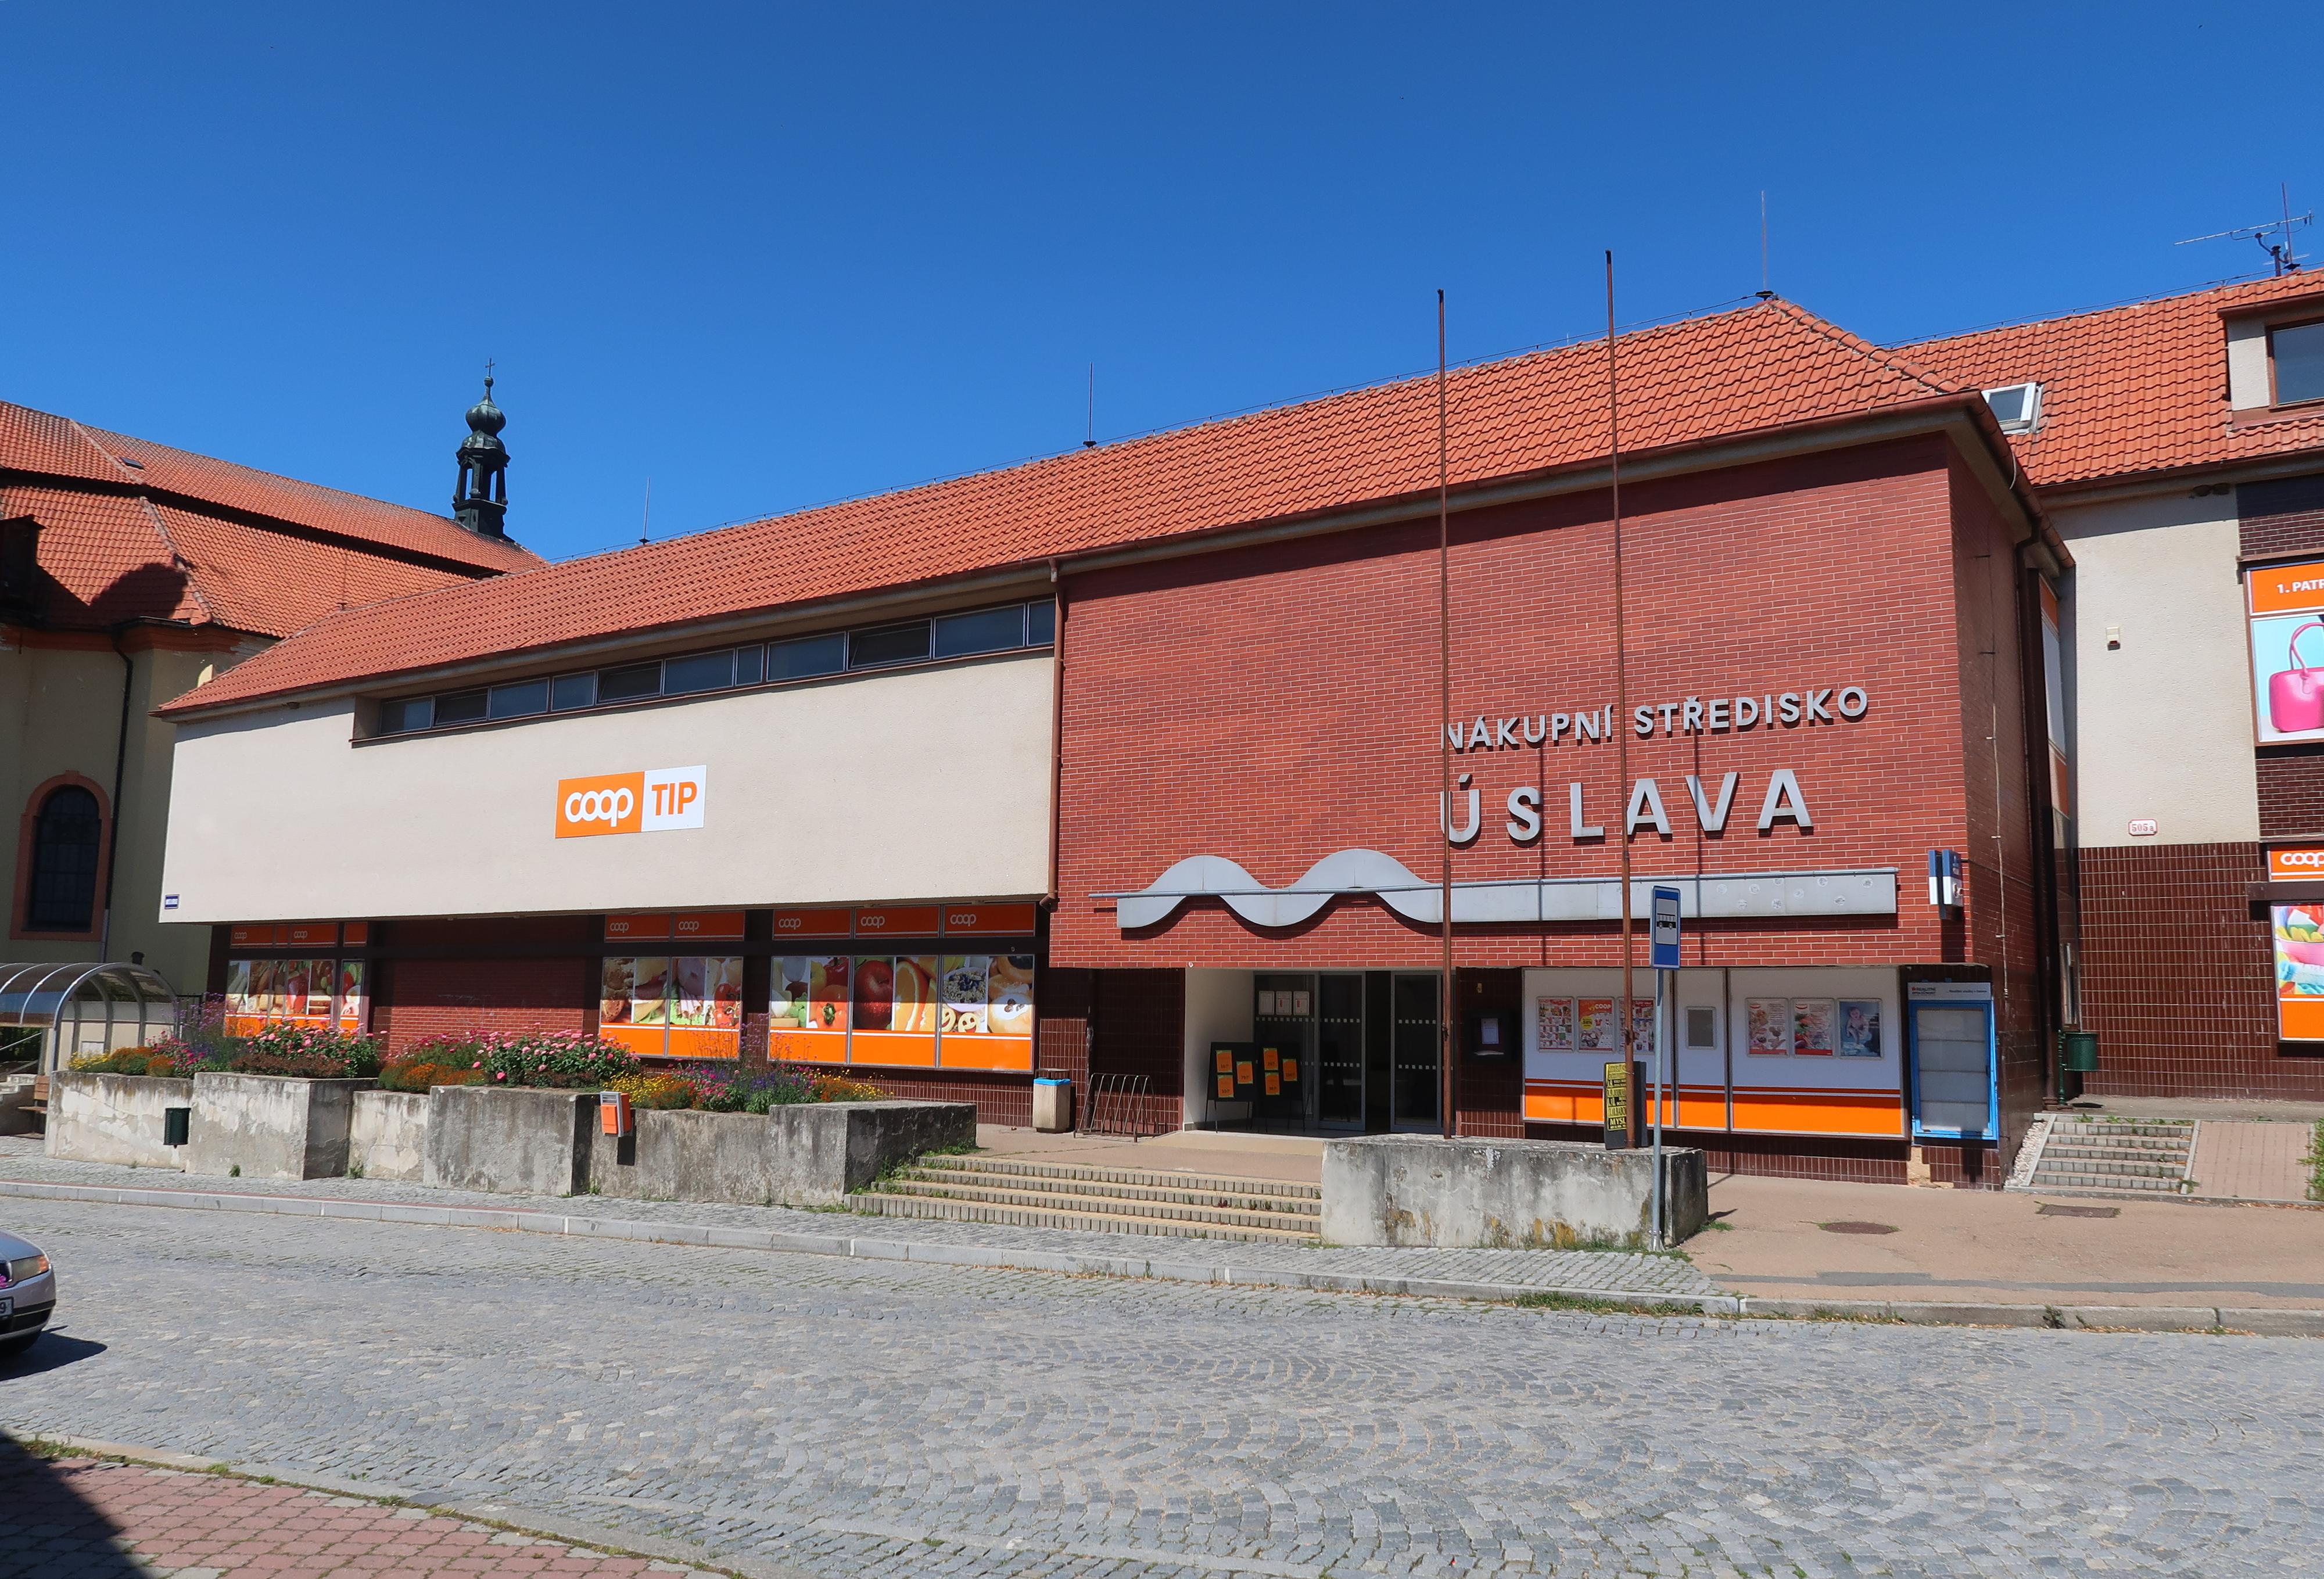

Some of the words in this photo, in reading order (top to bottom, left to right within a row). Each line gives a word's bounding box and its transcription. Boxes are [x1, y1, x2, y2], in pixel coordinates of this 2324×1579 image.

[2276, 583, 2290, 594] 1.
[1441, 704, 1613, 749] NÁKUPNÍ
[1634, 686, 1867, 734] STŘEDISKO
[565, 787, 634, 827] coop
[651, 781, 698, 816] TIP
[1440, 769, 1814, 842] ÚSLAVA
[2280, 852, 2324, 868] coop
[678, 921, 700, 932] coop
[779, 918, 801, 930] coop
[860, 916, 885, 928] coop
[950, 914, 977, 927] coop
[610, 922, 629, 933] coop
[234, 931, 248, 941] coop
[293, 931, 308, 939] coop
